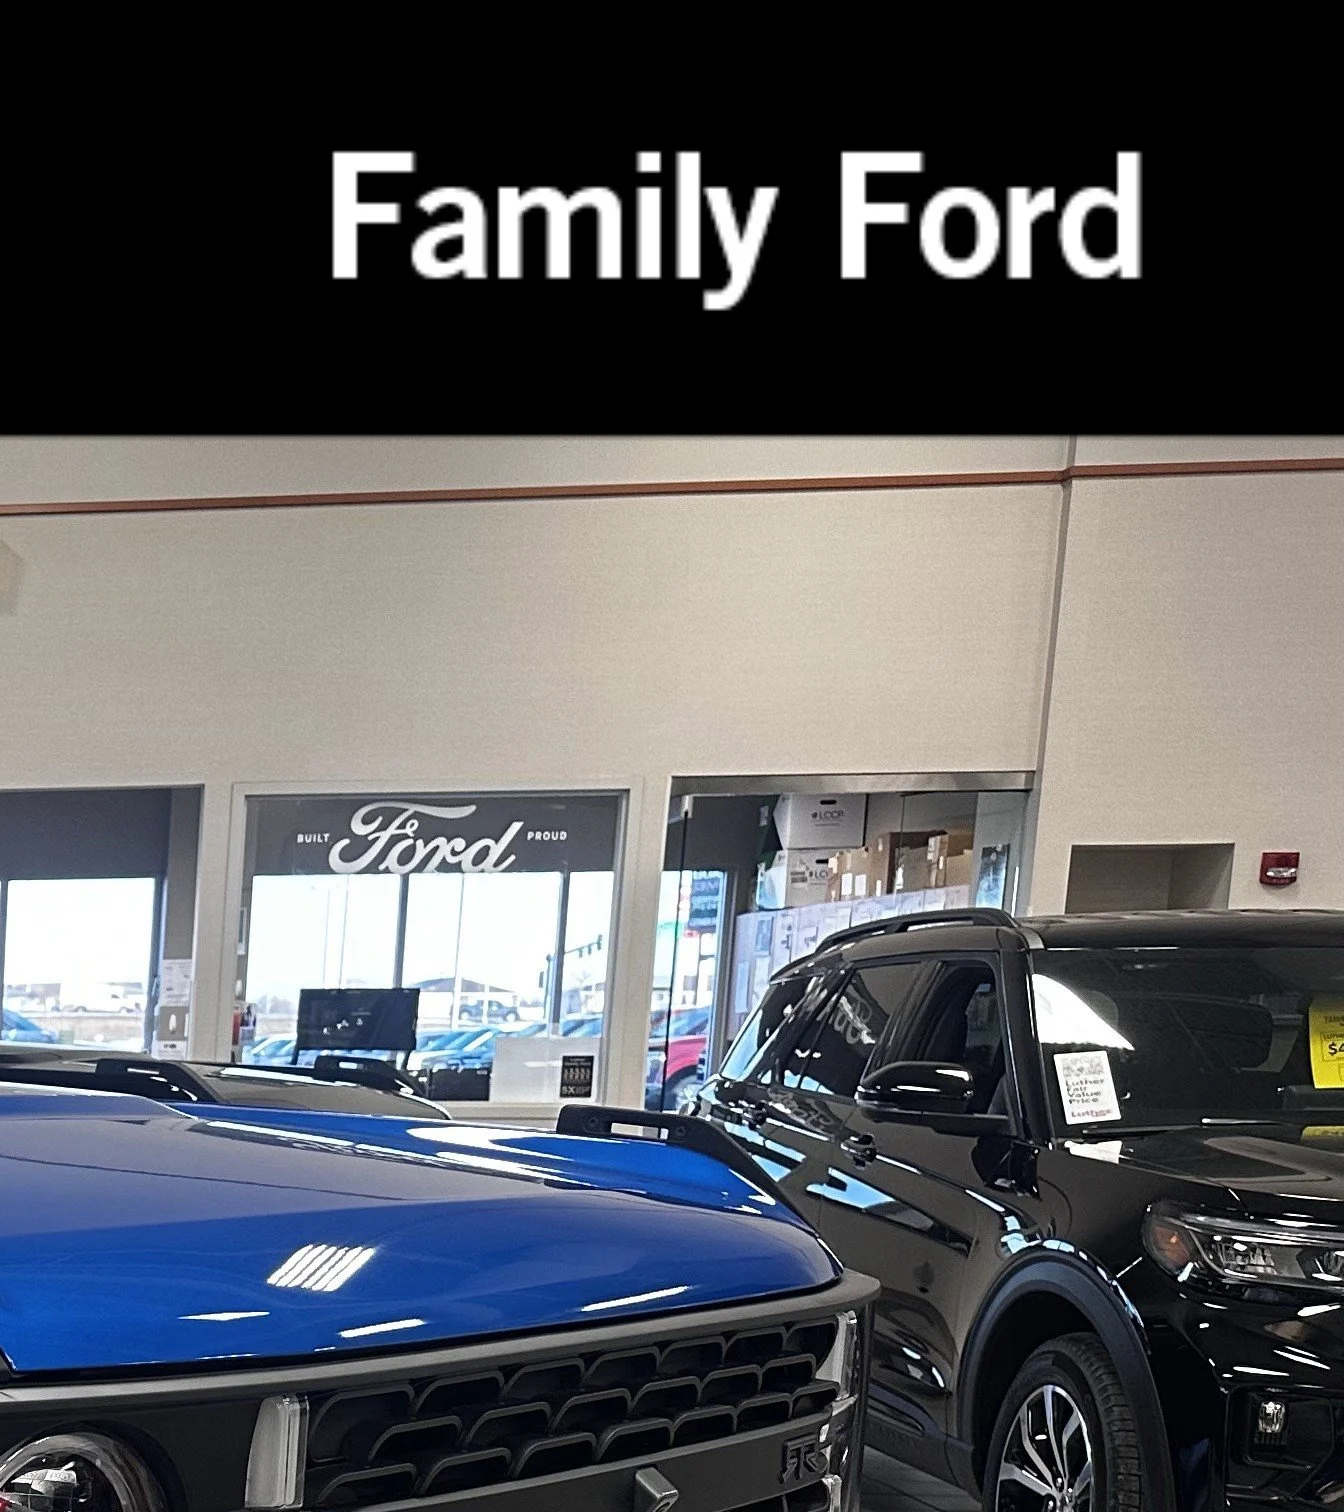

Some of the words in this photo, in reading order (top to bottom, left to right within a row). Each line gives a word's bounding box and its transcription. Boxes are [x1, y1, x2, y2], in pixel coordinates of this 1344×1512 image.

[296, 832, 330, 844] BUILT
[328, 800, 525, 875] Ford
[526, 830, 568, 841] PROUD
